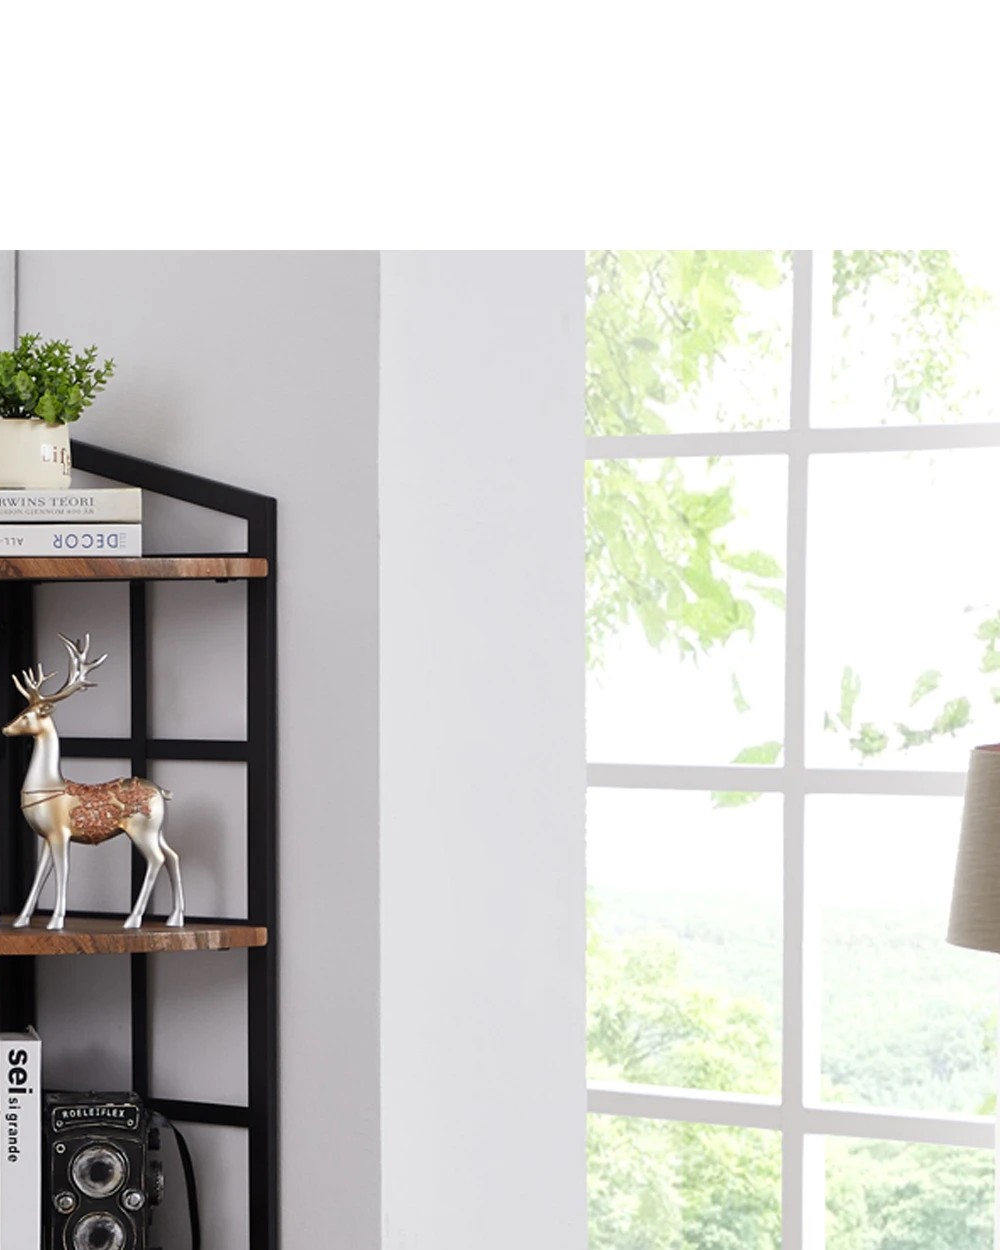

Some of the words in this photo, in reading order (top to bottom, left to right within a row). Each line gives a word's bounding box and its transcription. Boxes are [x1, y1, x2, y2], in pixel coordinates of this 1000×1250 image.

[49, 496, 95, 508] TEORI
[53, 533, 119, 549] DECOR
[8, 1049, 33, 1094] sei
[8, 1097, 22, 1110] si
[5, 1113, 21, 1163] grande
